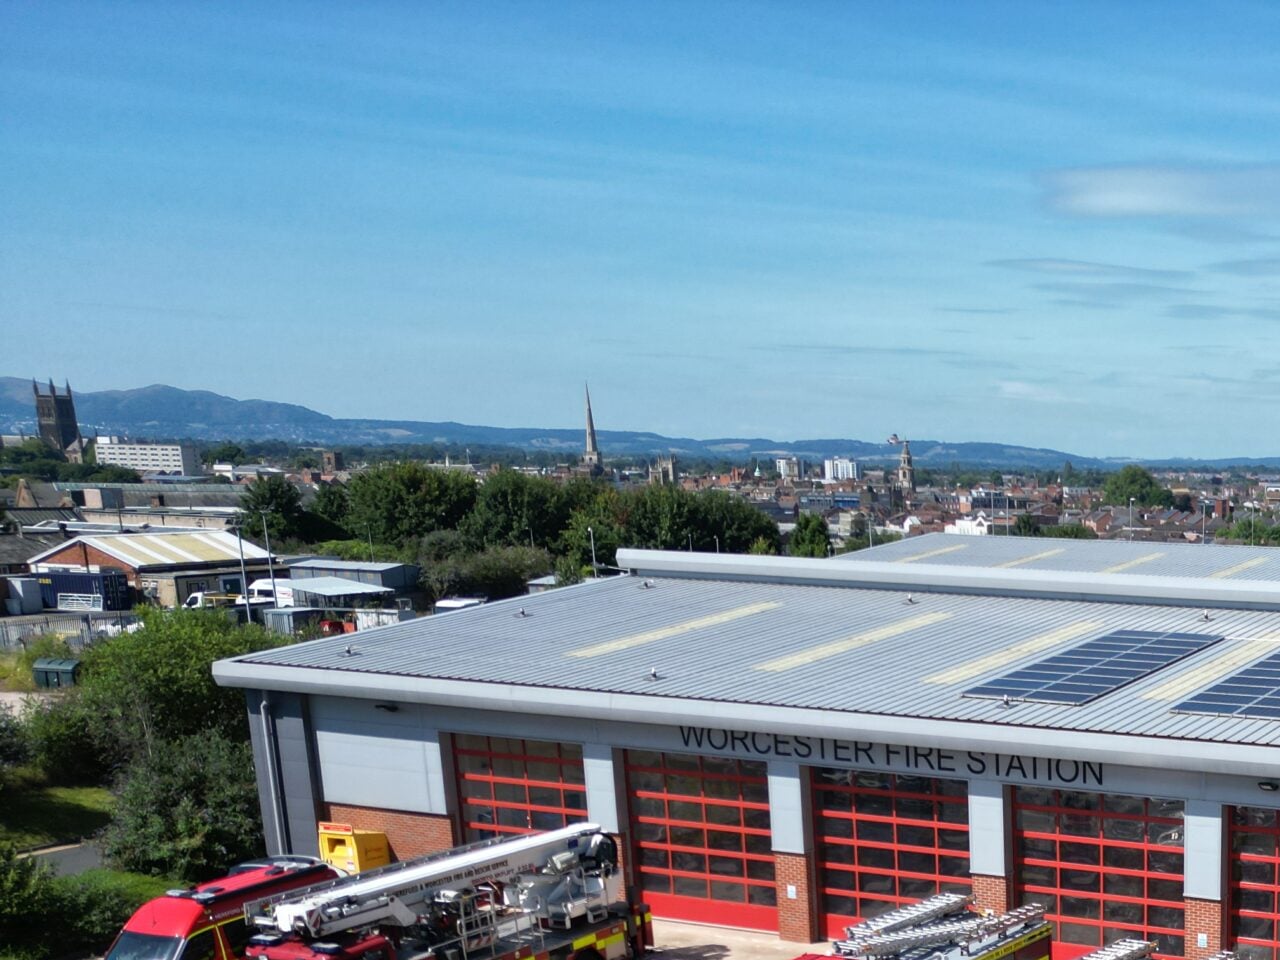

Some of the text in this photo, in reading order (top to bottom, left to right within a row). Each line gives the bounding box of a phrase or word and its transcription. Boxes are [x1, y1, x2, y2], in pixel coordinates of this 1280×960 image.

[679, 725, 1103, 786] WORCESTER FIRE STATION
